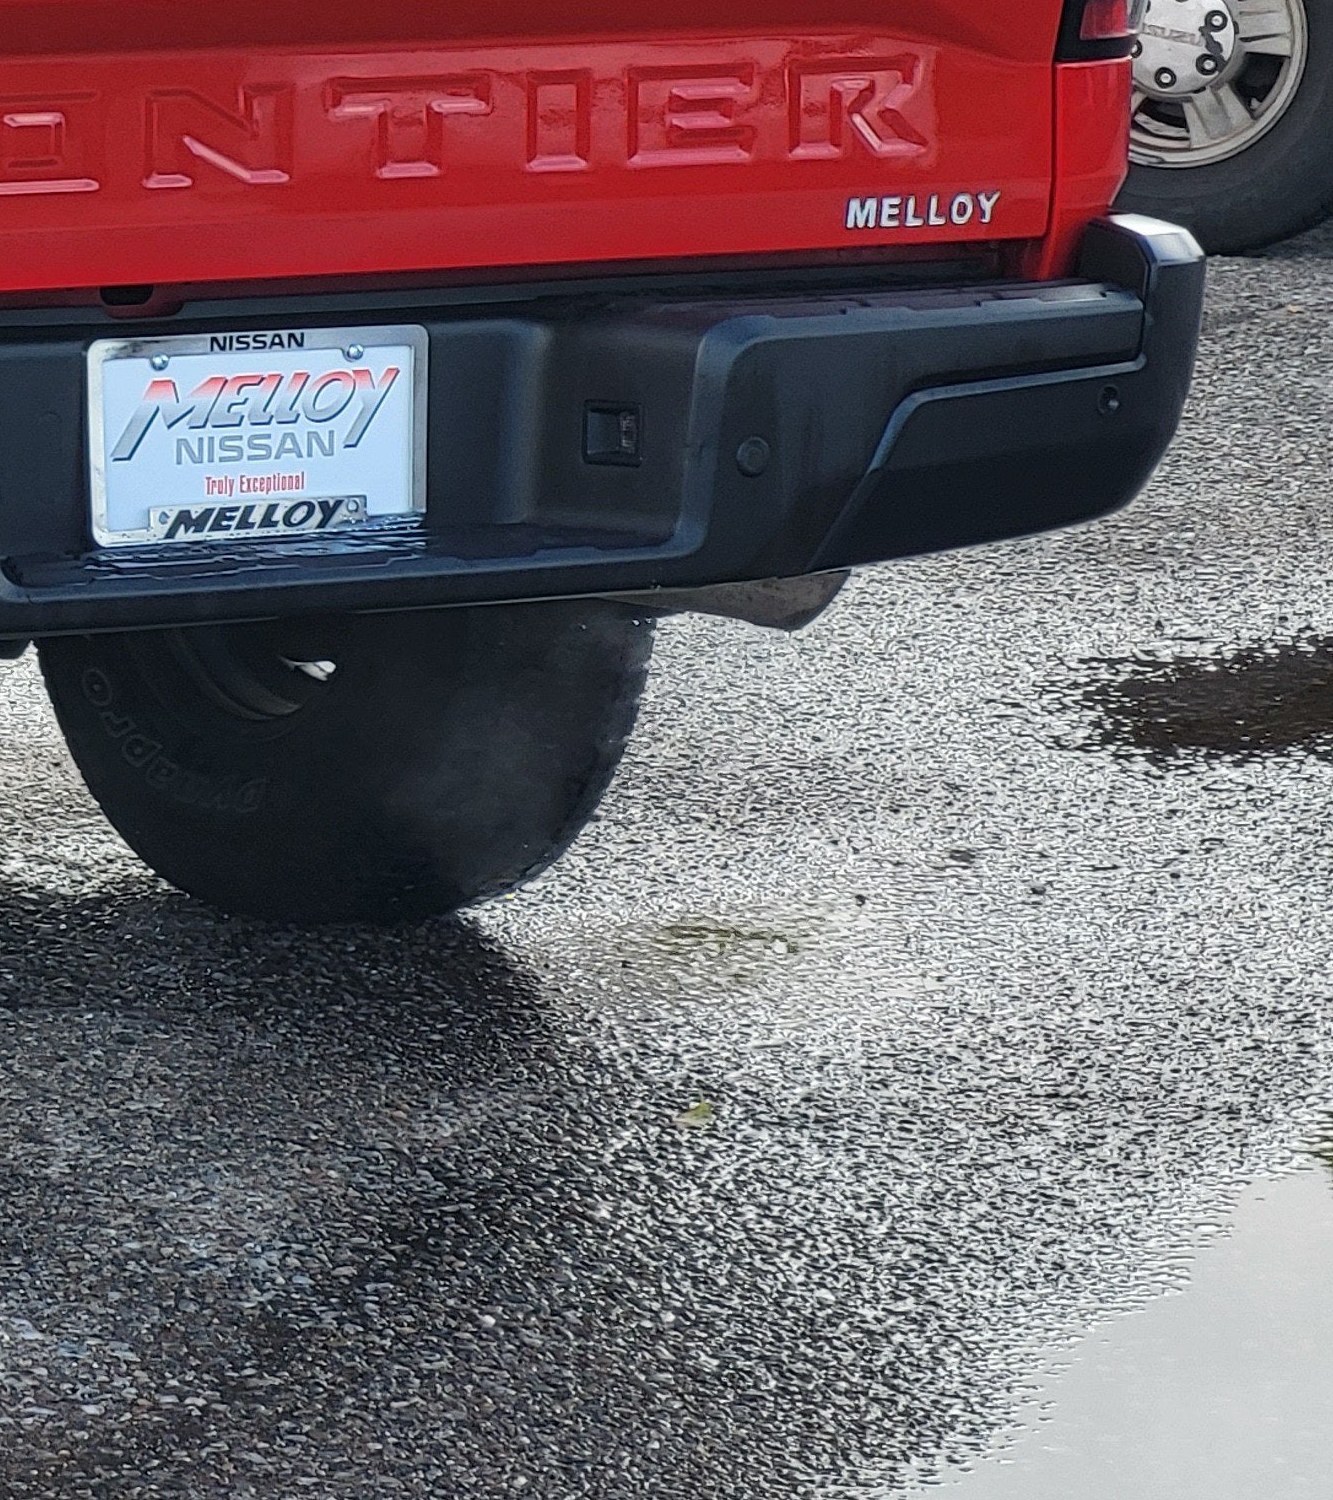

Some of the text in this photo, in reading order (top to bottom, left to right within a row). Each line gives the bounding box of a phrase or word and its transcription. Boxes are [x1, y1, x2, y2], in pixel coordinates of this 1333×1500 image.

[845, 190, 1002, 230] MELLOY
[209, 332, 306, 353] NISSAN
[110, 366, 401, 462] MELLOY
[175, 430, 336, 465] NISSAN
[204, 471, 306, 497] Truly Exceptional
[162, 499, 347, 541] MELLOY
